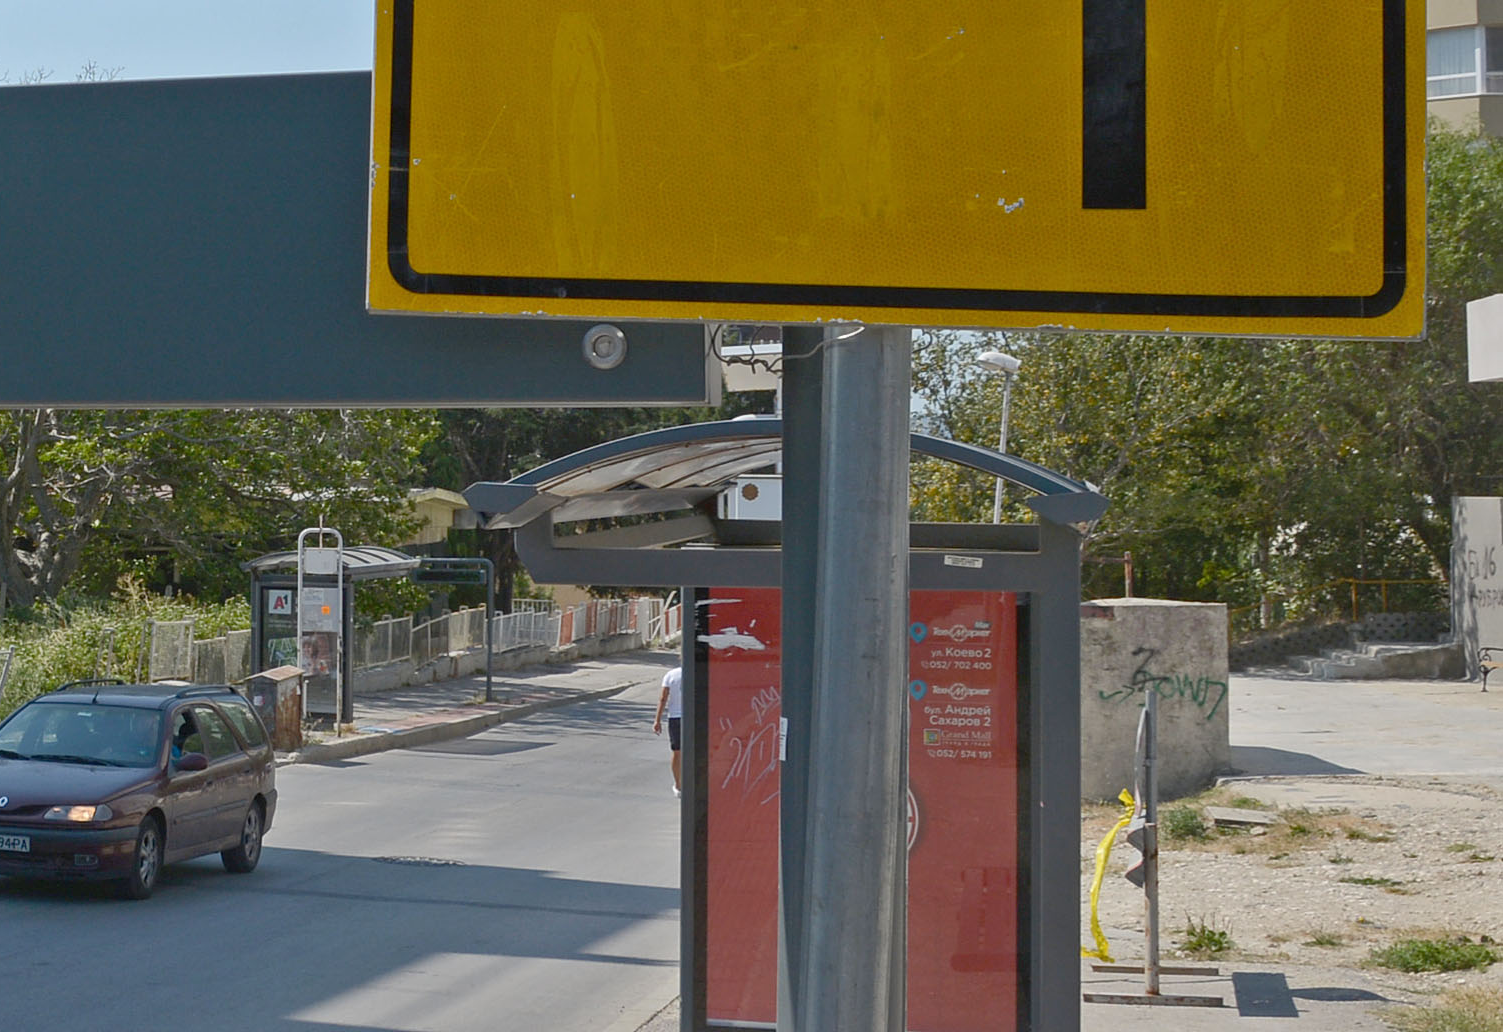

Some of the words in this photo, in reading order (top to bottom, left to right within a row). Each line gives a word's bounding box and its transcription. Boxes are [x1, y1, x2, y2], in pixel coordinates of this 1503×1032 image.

[945, 648, 983, 658] Коево
[984, 648, 992, 658] 2
[944, 704, 991, 716] Андрей
[929, 715, 981, 727] Сахаров
[983, 716, 991, 727] 2
